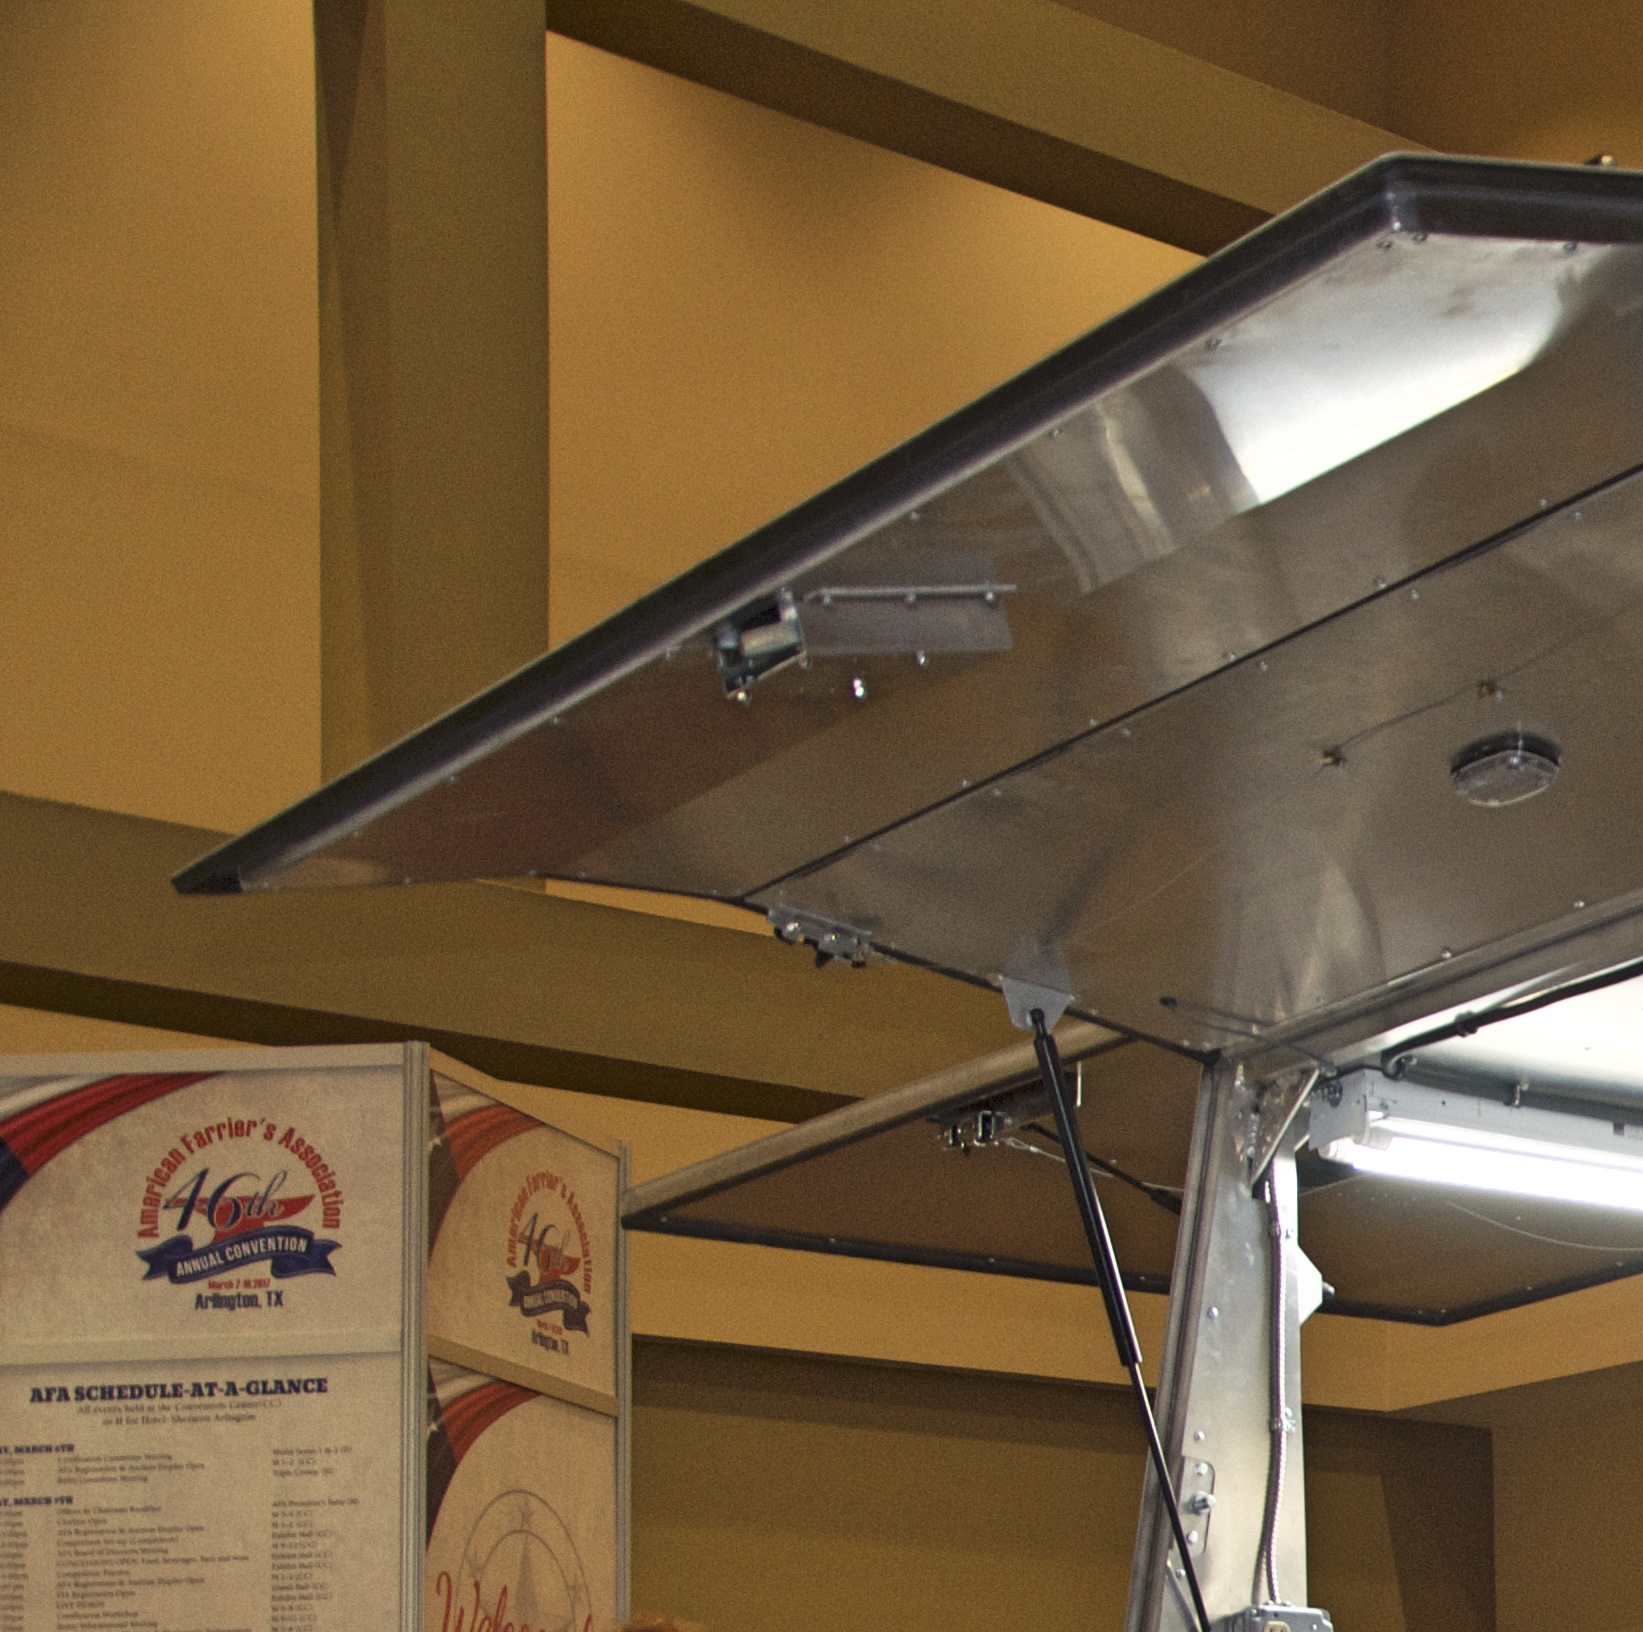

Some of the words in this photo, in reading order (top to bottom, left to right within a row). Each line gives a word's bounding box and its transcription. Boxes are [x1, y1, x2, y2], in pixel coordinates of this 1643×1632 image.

[137, 1148, 187, 1239] American
[180, 1116, 278, 1156] Farrier's
[277, 1126, 344, 1230] Association
[162, 1166, 289, 1232] 46th
[175, 1251, 224, 1277] ANNUAL
[225, 1235, 309, 1262] CONVENTION
[266, 1289, 285, 1308] TX
[30, 1385, 71, 1404] AFA
[74, 1377, 329, 1402] SCHEDULE-AT-A-GLANCE
